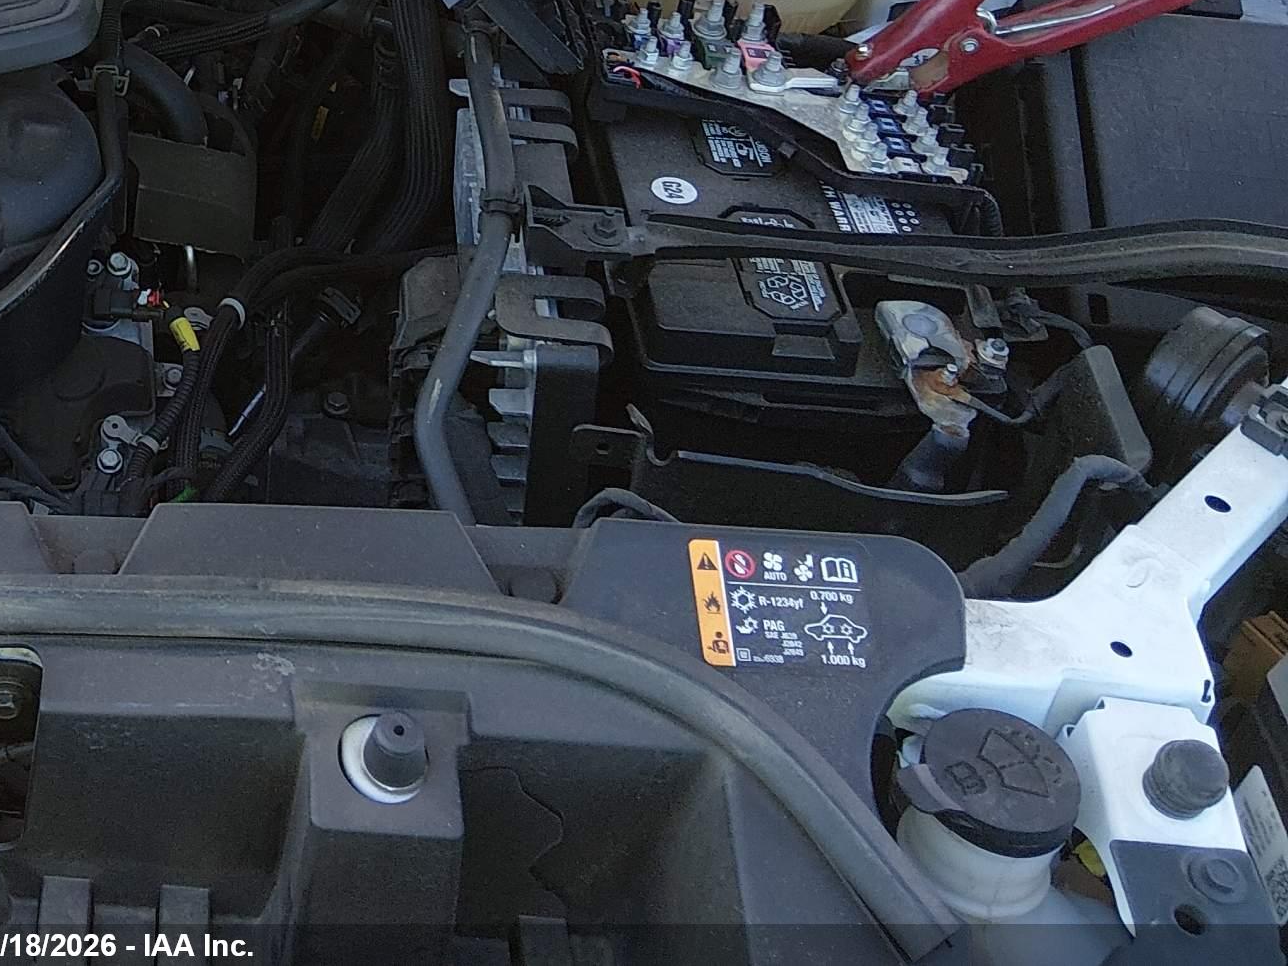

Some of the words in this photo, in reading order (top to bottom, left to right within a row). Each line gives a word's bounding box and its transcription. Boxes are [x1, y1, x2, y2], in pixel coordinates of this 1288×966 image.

[662, 180, 685, 199] G24
[764, 572, 787, 581] AUTO
[759, 596, 803, 609] R-1234yf
[810, 590, 838, 602] 0.700
[839, 592, 854, 604] kg
[763, 619, 786, 631] PAG
[821, 654, 850, 666] 1.000
[851, 656, 866, 668] kg
